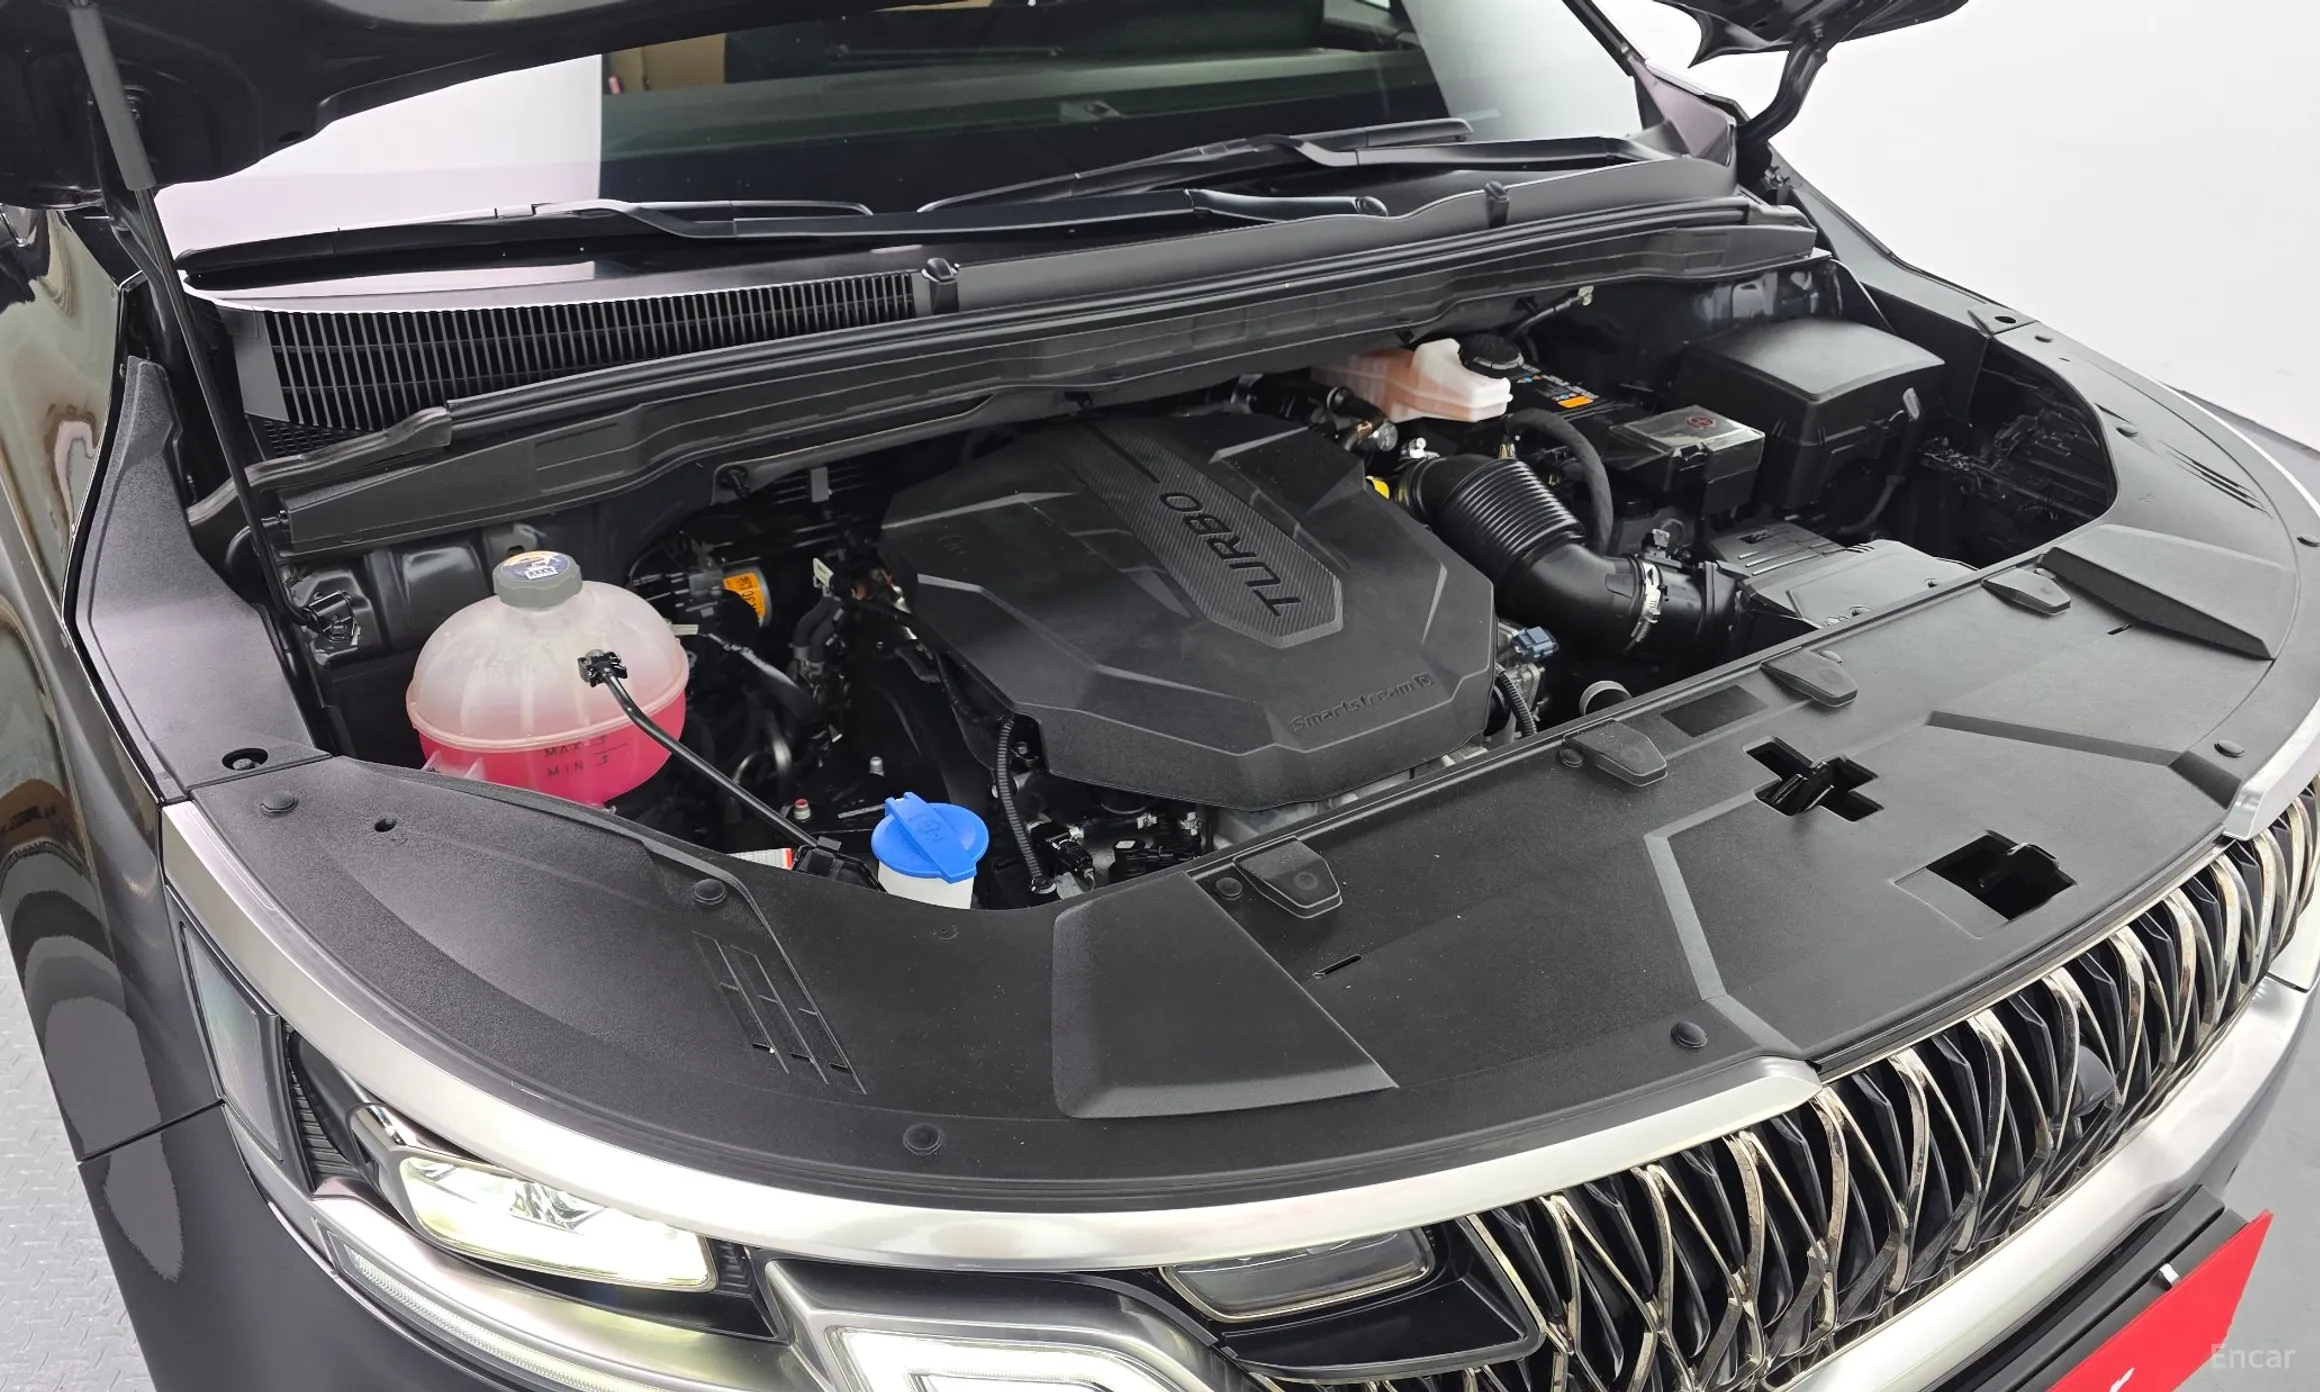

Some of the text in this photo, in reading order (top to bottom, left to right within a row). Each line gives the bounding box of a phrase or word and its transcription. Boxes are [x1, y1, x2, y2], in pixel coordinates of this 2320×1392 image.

[1160, 492, 1302, 617] TURBO
[1291, 681, 1416, 732] Smartstream
[545, 741, 582, 758] MAX
[547, 761, 584, 777] MIN
